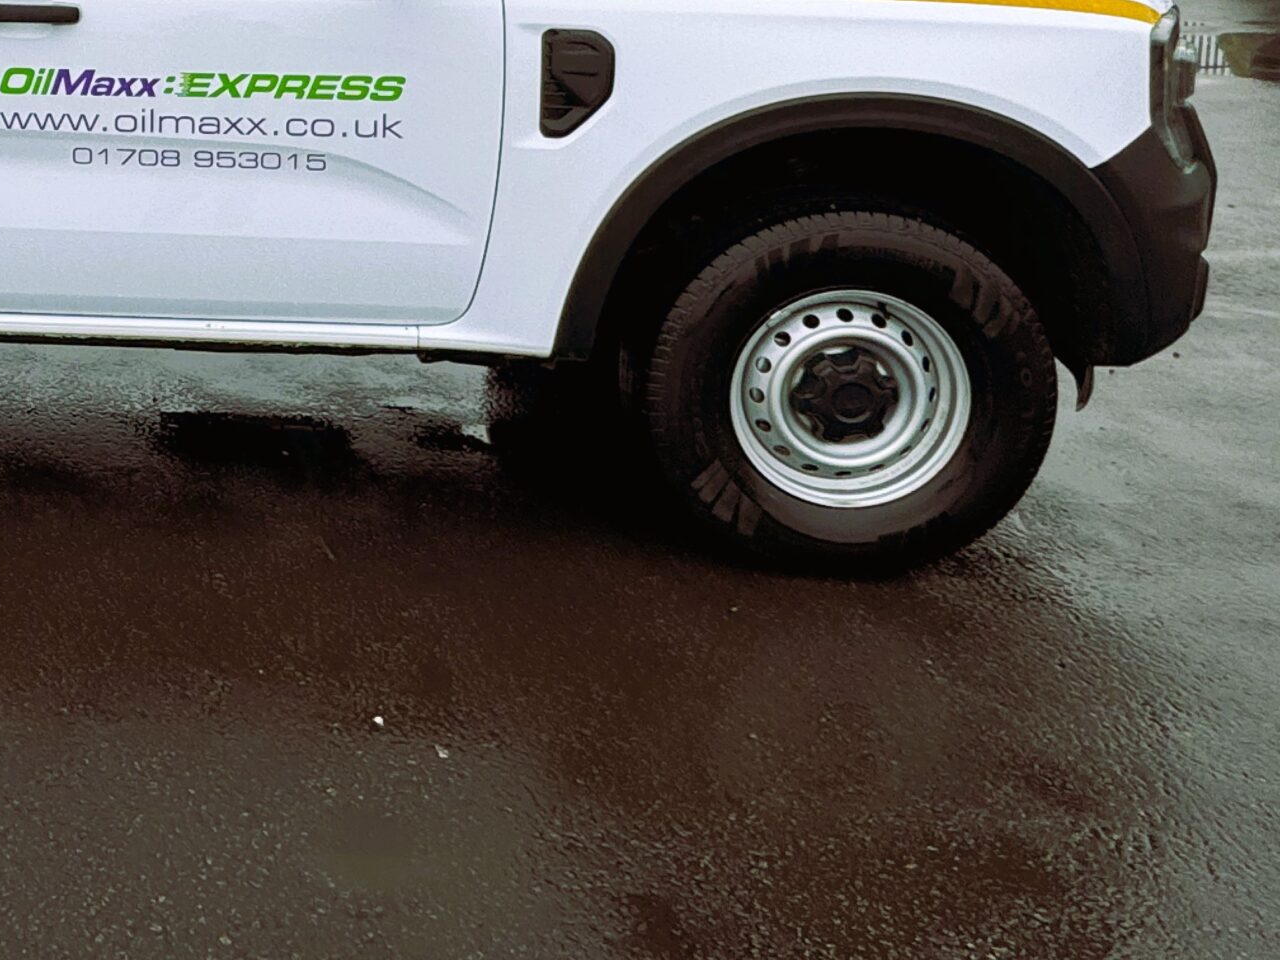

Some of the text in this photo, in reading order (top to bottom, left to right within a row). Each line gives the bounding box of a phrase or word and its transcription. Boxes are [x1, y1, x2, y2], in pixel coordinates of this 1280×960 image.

[0, 108, 403, 139] www.oilmaxx.co.uk
[72, 147, 327, 172] 01708 953015
